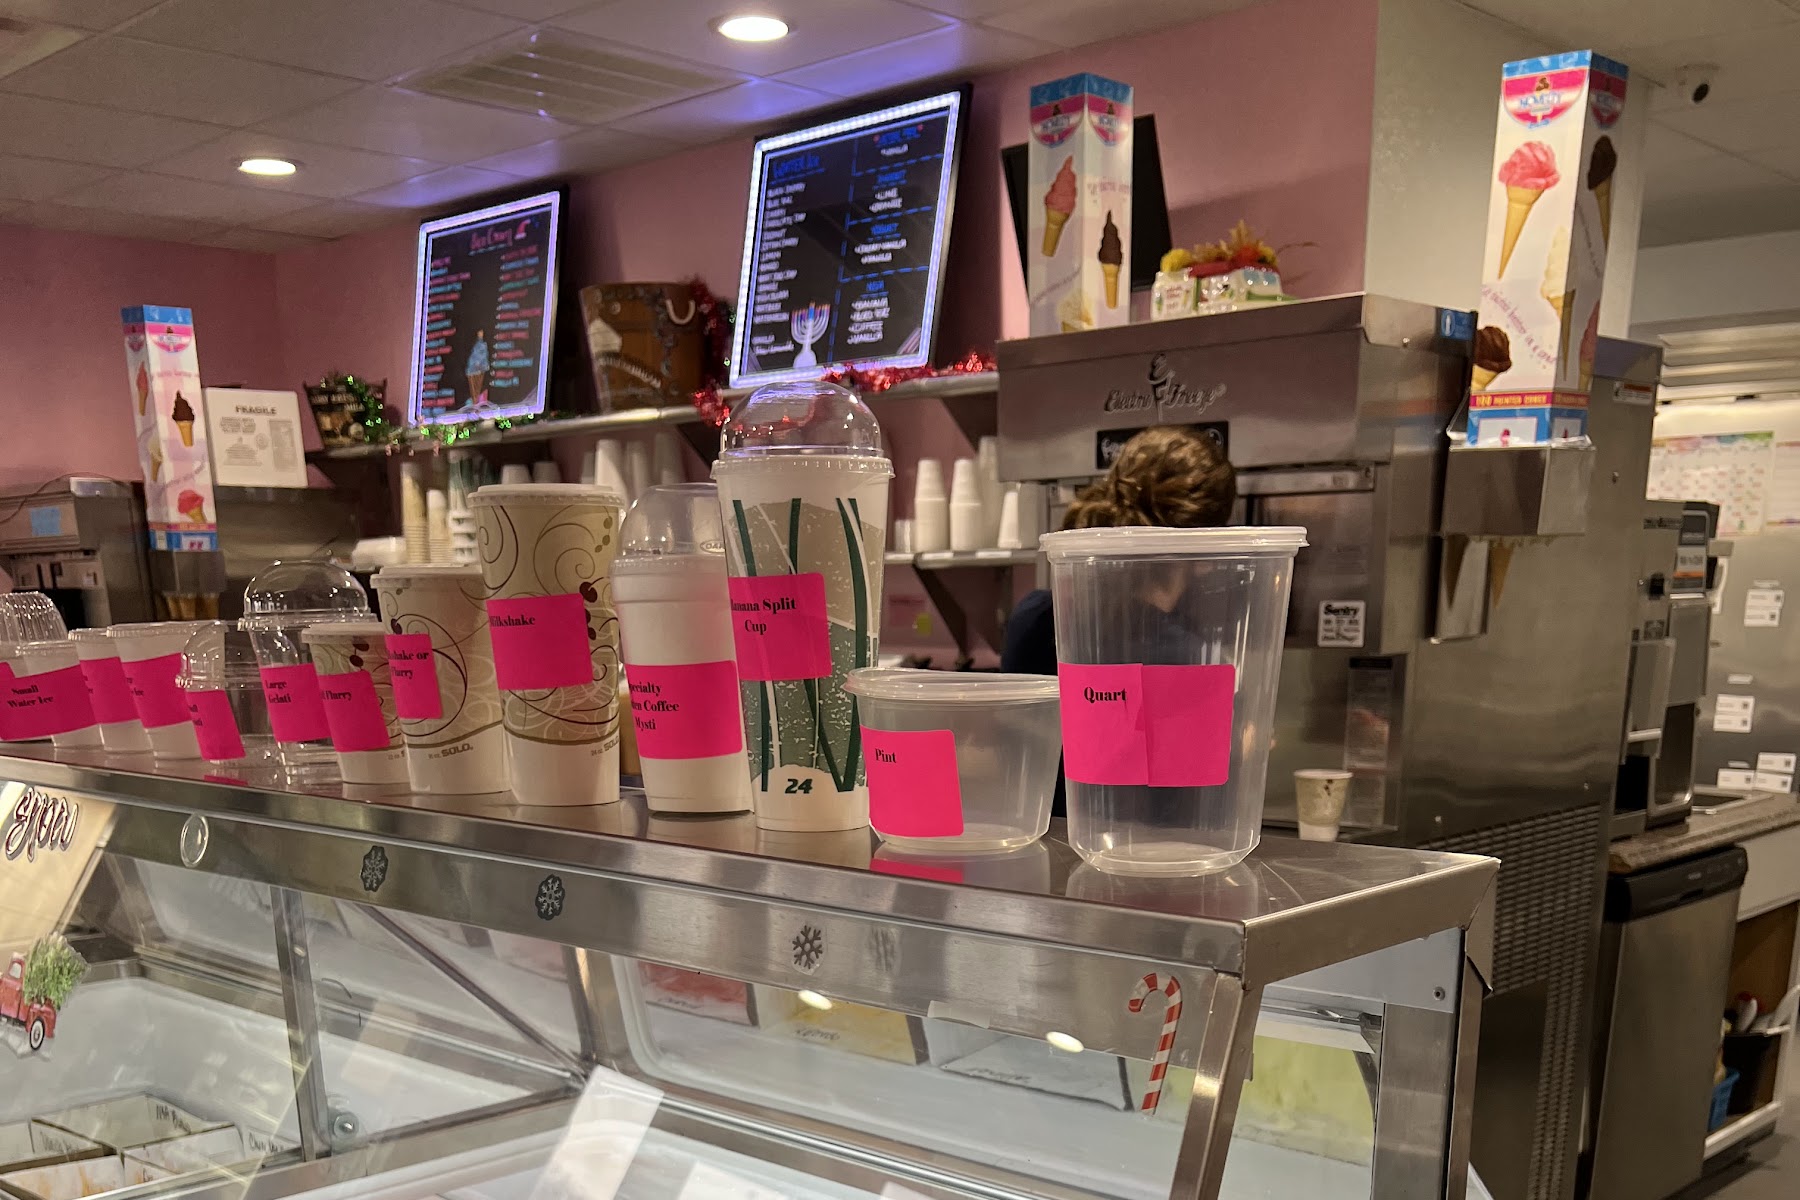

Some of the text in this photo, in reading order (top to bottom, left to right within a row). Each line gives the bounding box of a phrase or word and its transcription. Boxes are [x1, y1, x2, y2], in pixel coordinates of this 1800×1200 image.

[762, 597, 797, 615] Split
[744, 619, 767, 636] Cup
[416, 651, 430, 660] or
[11, 684, 39, 696] Small
[628, 681, 661, 698] pecialty
[1083, 686, 1127, 704] Quart
[8, 697, 38, 709] Water
[643, 699, 680, 712] Coffee
[441, 743, 470, 758] SOLO
[874, 747, 897, 764] Pint
[785, 778, 813, 795] 24
